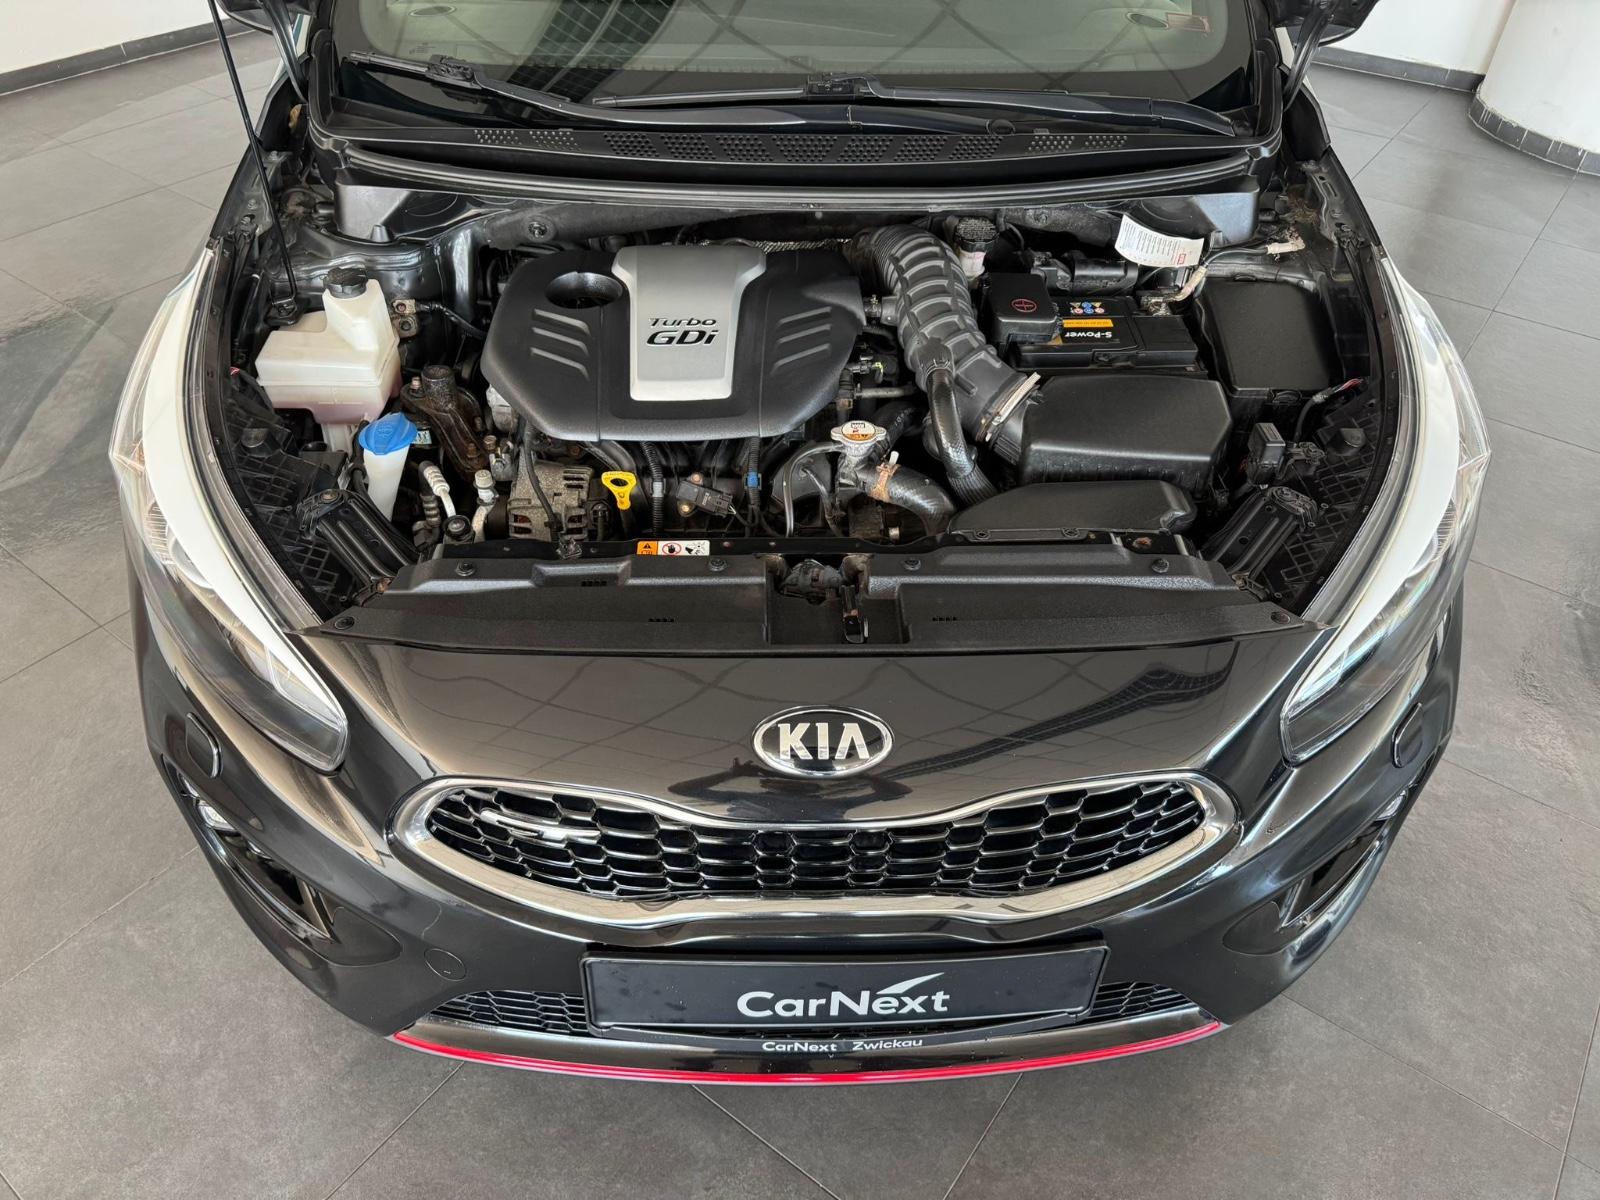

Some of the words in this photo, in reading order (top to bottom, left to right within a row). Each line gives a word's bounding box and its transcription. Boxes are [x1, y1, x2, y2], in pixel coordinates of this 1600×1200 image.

[649, 317, 717, 327] Turbo
[646, 329, 719, 346] GDi
[1064, 331, 1113, 339] S-Power
[777, 722, 871, 761] KIA
[736, 990, 950, 1018] CarNext
[761, 1041, 838, 1052] CarNext
[852, 1039, 923, 1051] Zwickau
